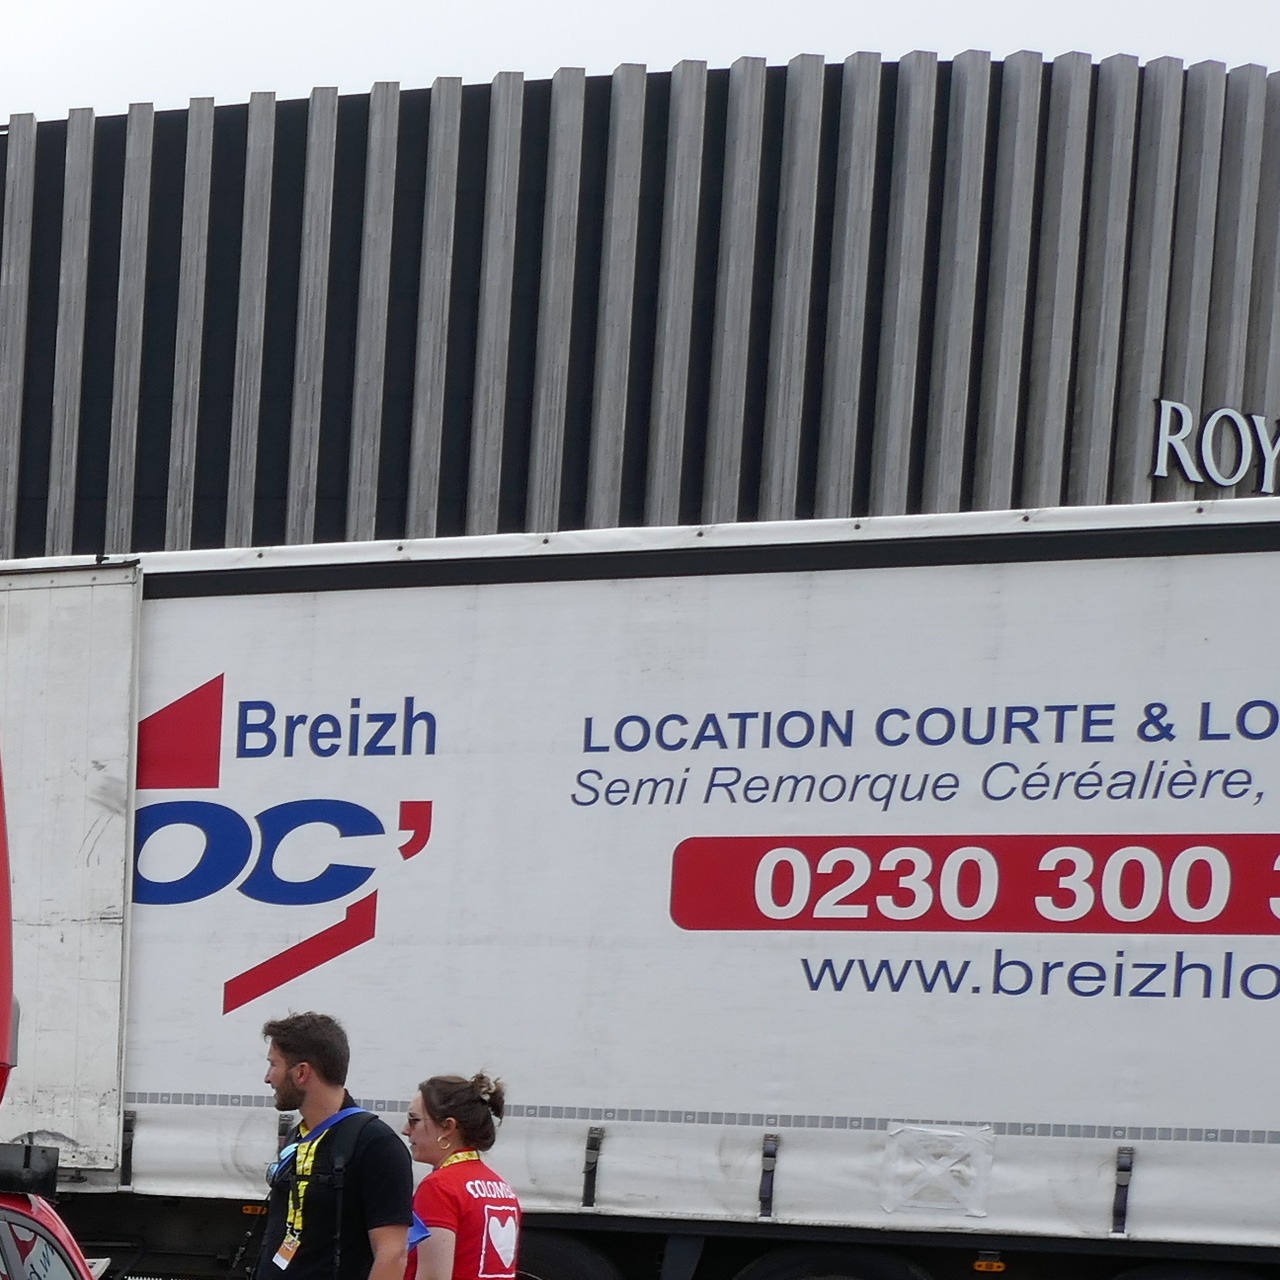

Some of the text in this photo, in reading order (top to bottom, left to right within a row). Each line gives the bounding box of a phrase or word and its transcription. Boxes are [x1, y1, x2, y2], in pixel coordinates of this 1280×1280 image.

[1153, 399, 1280, 494] ROY
[236, 696, 438, 758] Breizh
[582, 699, 1280, 754] LOCATION COURTE & LO
[570, 760, 1266, 812] Semi Remorque Céréalière,
[752, 845, 1000, 921] 0230
[1034, 845, 1232, 923] 300
[800, 948, 1280, 1001] www.breizhlo
